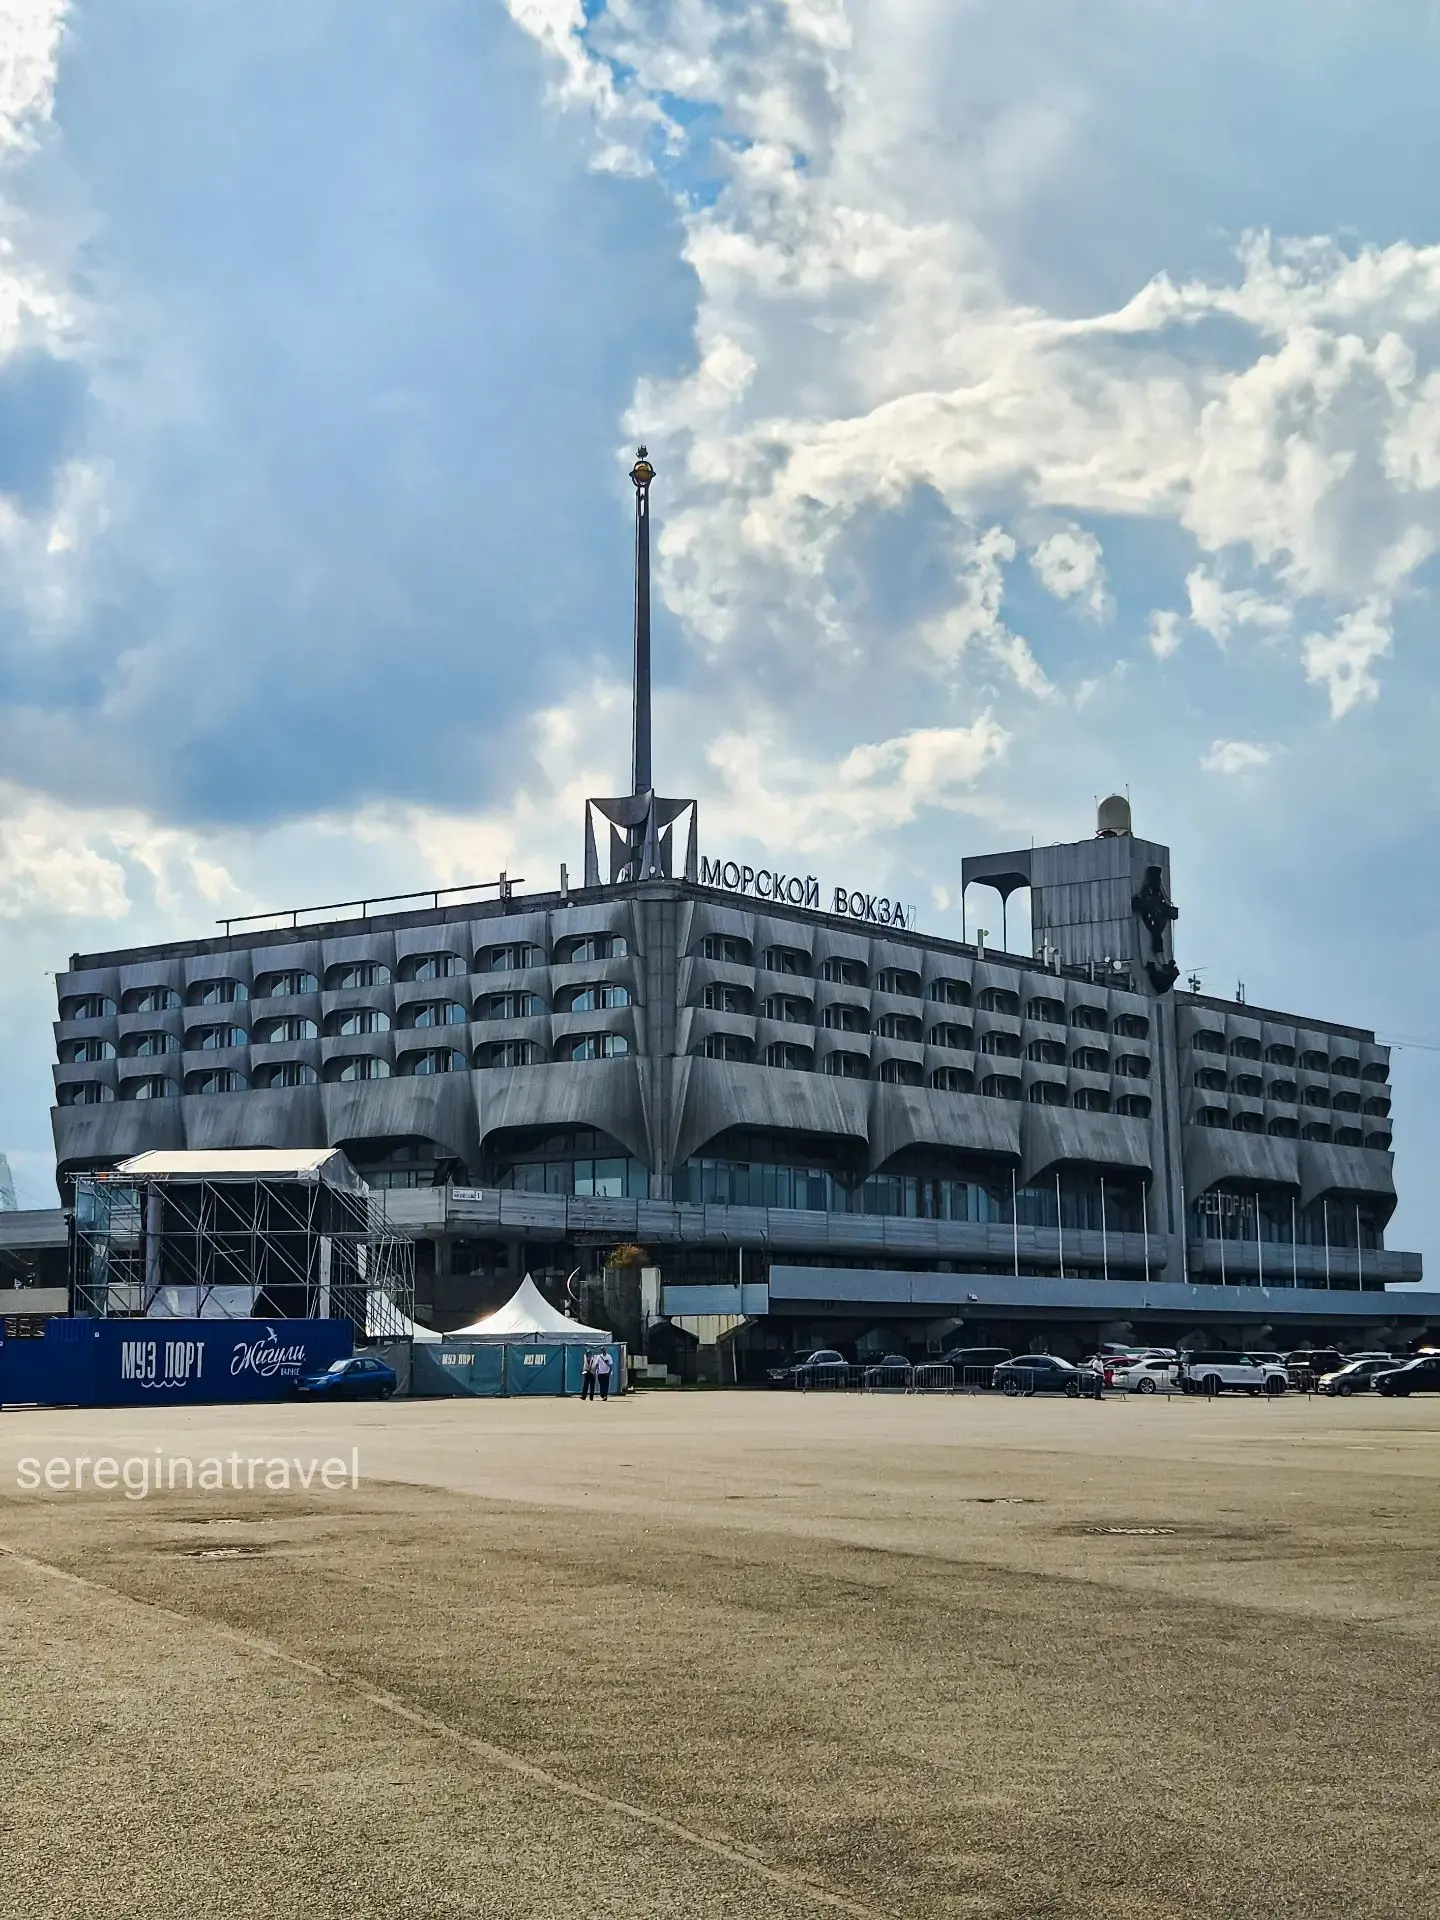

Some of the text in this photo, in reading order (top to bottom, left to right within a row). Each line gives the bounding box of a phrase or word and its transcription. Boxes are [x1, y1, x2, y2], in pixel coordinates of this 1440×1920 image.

[701, 855, 820, 908] МОРСКОЙ
[121, 1341, 205, 1379] МУЗ ПОРТ
[230, 1339, 306, 1377] Жигули
